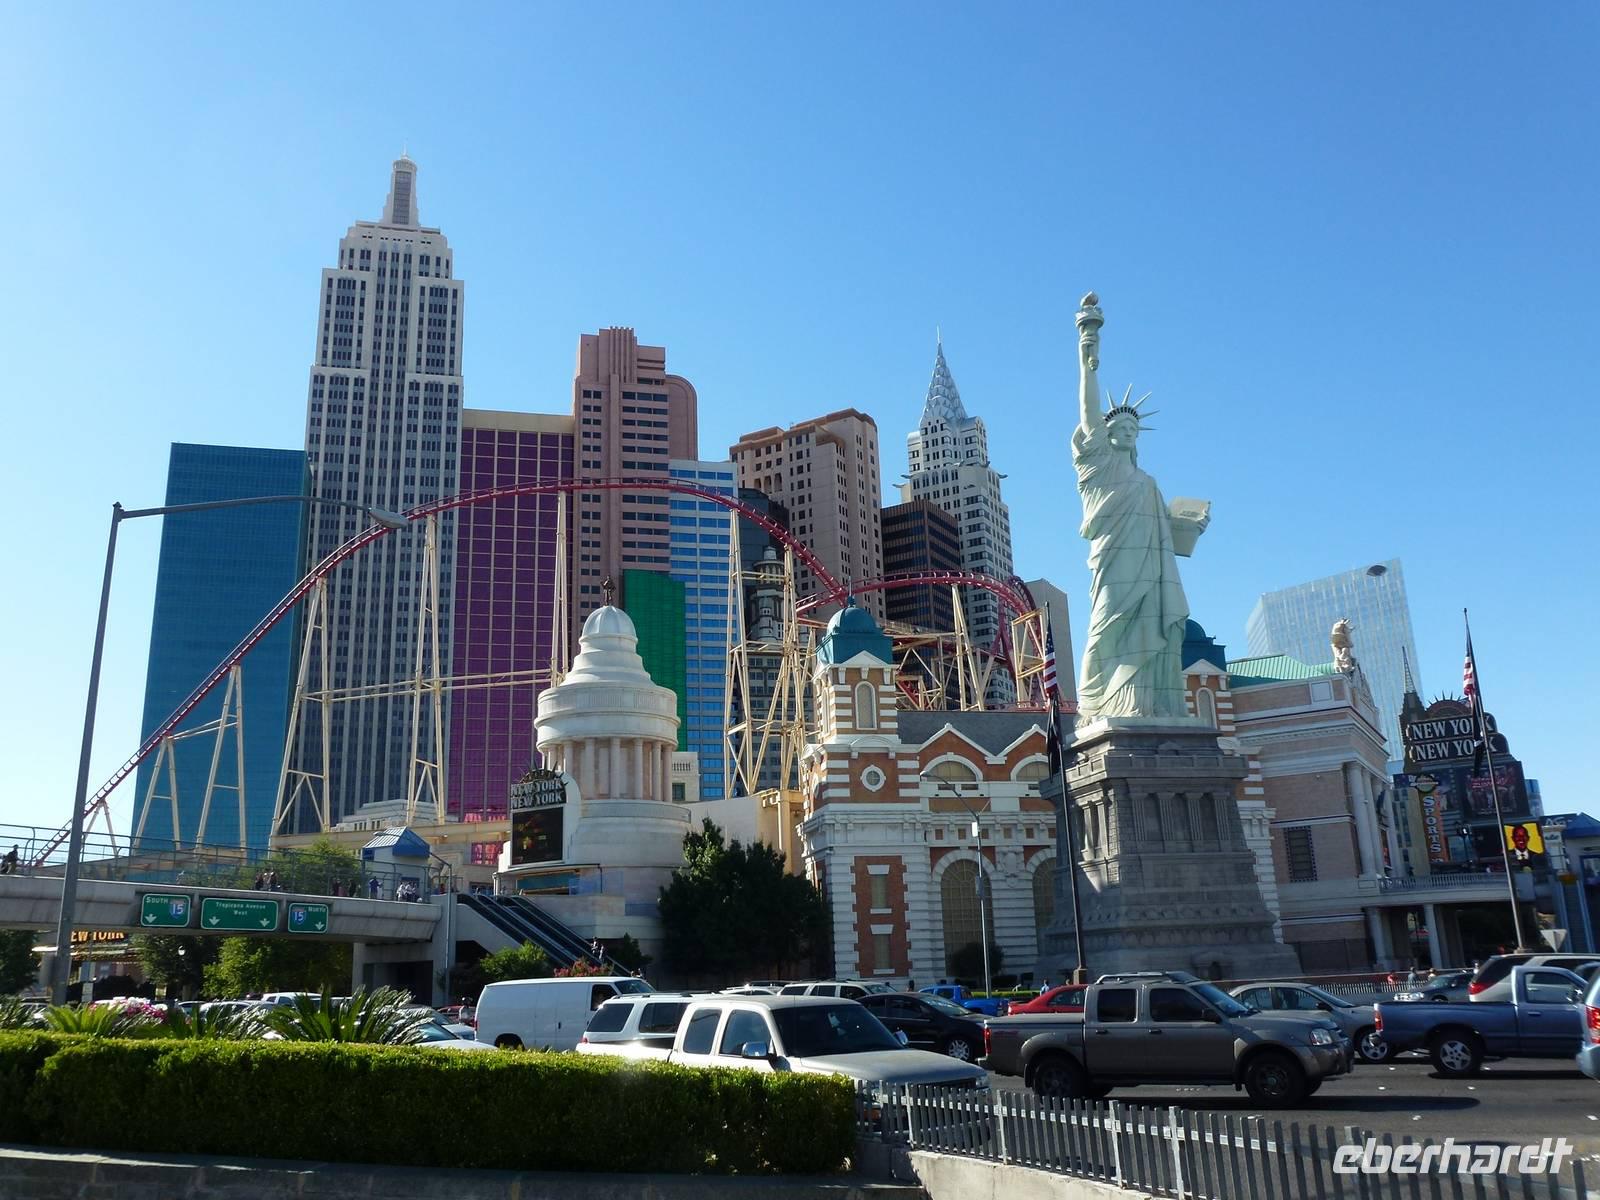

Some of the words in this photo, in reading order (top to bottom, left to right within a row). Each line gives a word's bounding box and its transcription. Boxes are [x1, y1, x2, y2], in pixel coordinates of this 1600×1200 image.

[1411, 720, 1446, 740] NEW
[1450, 717, 1493, 735] YOK
[1415, 741, 1450, 761] NEW
[1453, 736, 1497, 756] YOK
[511, 783, 533, 796] NEW
[535, 778, 562, 792] YORK
[511, 794, 533, 809] NEW
[535, 791, 562, 805] YORK
[1423, 795, 1442, 853] SPORTS
[172, 903, 184, 915] 15
[294, 911, 305, 923] 15
